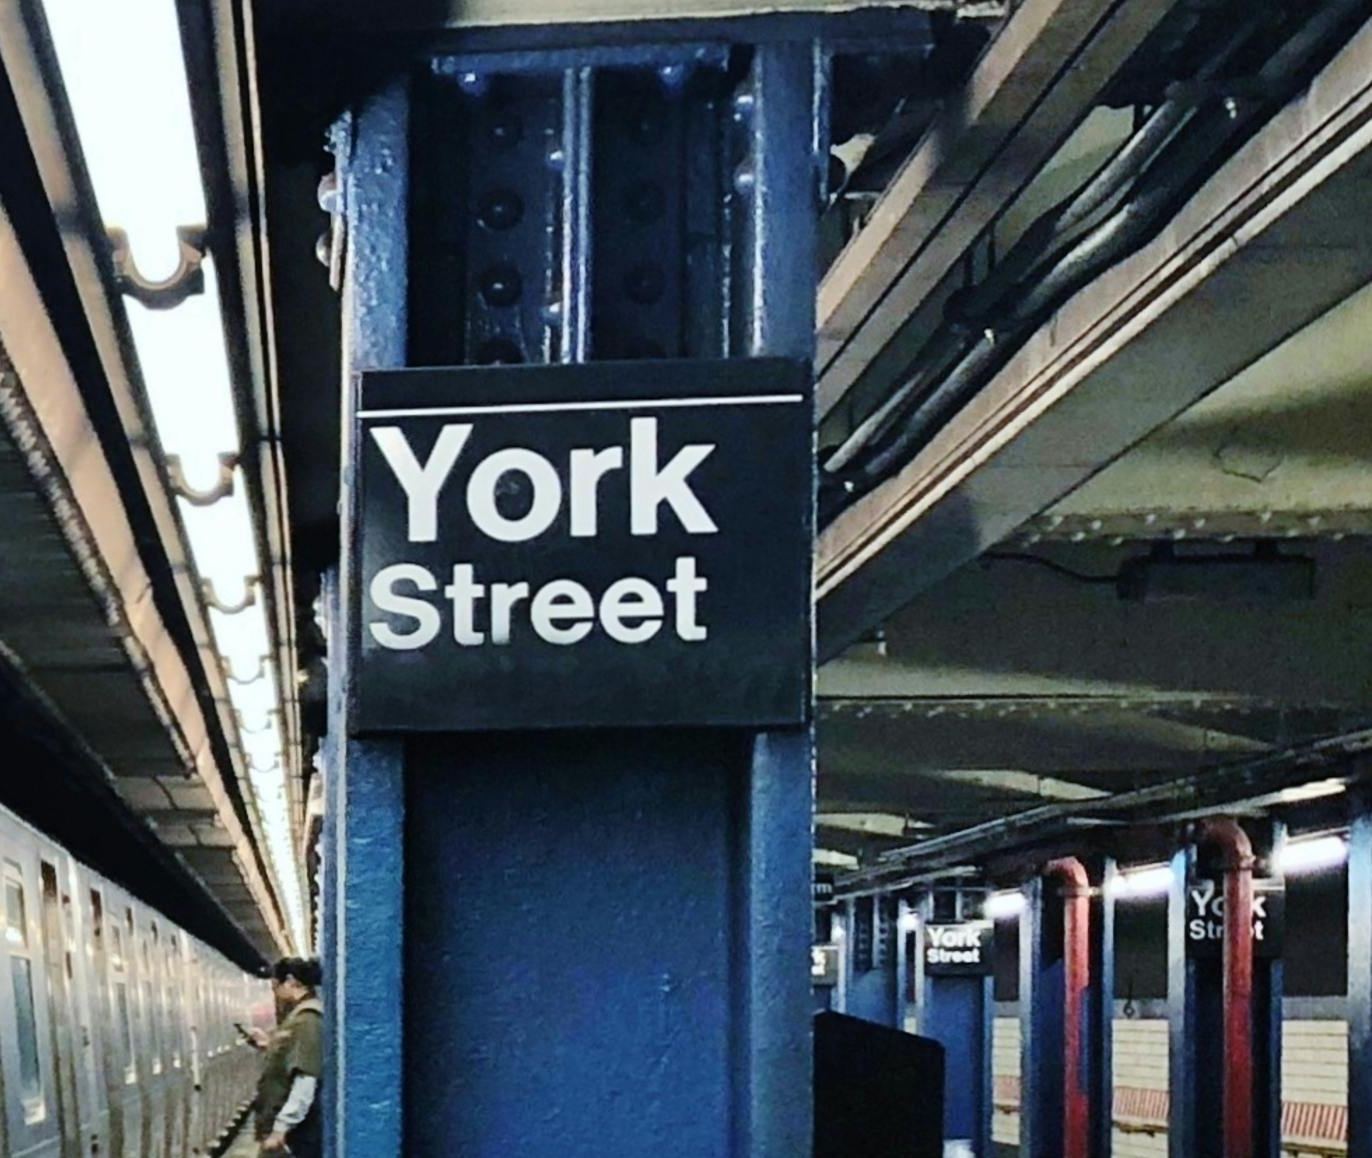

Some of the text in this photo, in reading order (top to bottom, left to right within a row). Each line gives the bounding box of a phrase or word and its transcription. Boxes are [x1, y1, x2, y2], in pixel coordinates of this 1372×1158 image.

[369, 416, 718, 542] York
[368, 557, 708, 650] Street
[1190, 886, 1266, 917] Yok
[927, 927, 981, 948] York
[1189, 919, 1264, 940] Strt
[926, 947, 980, 963] Street
